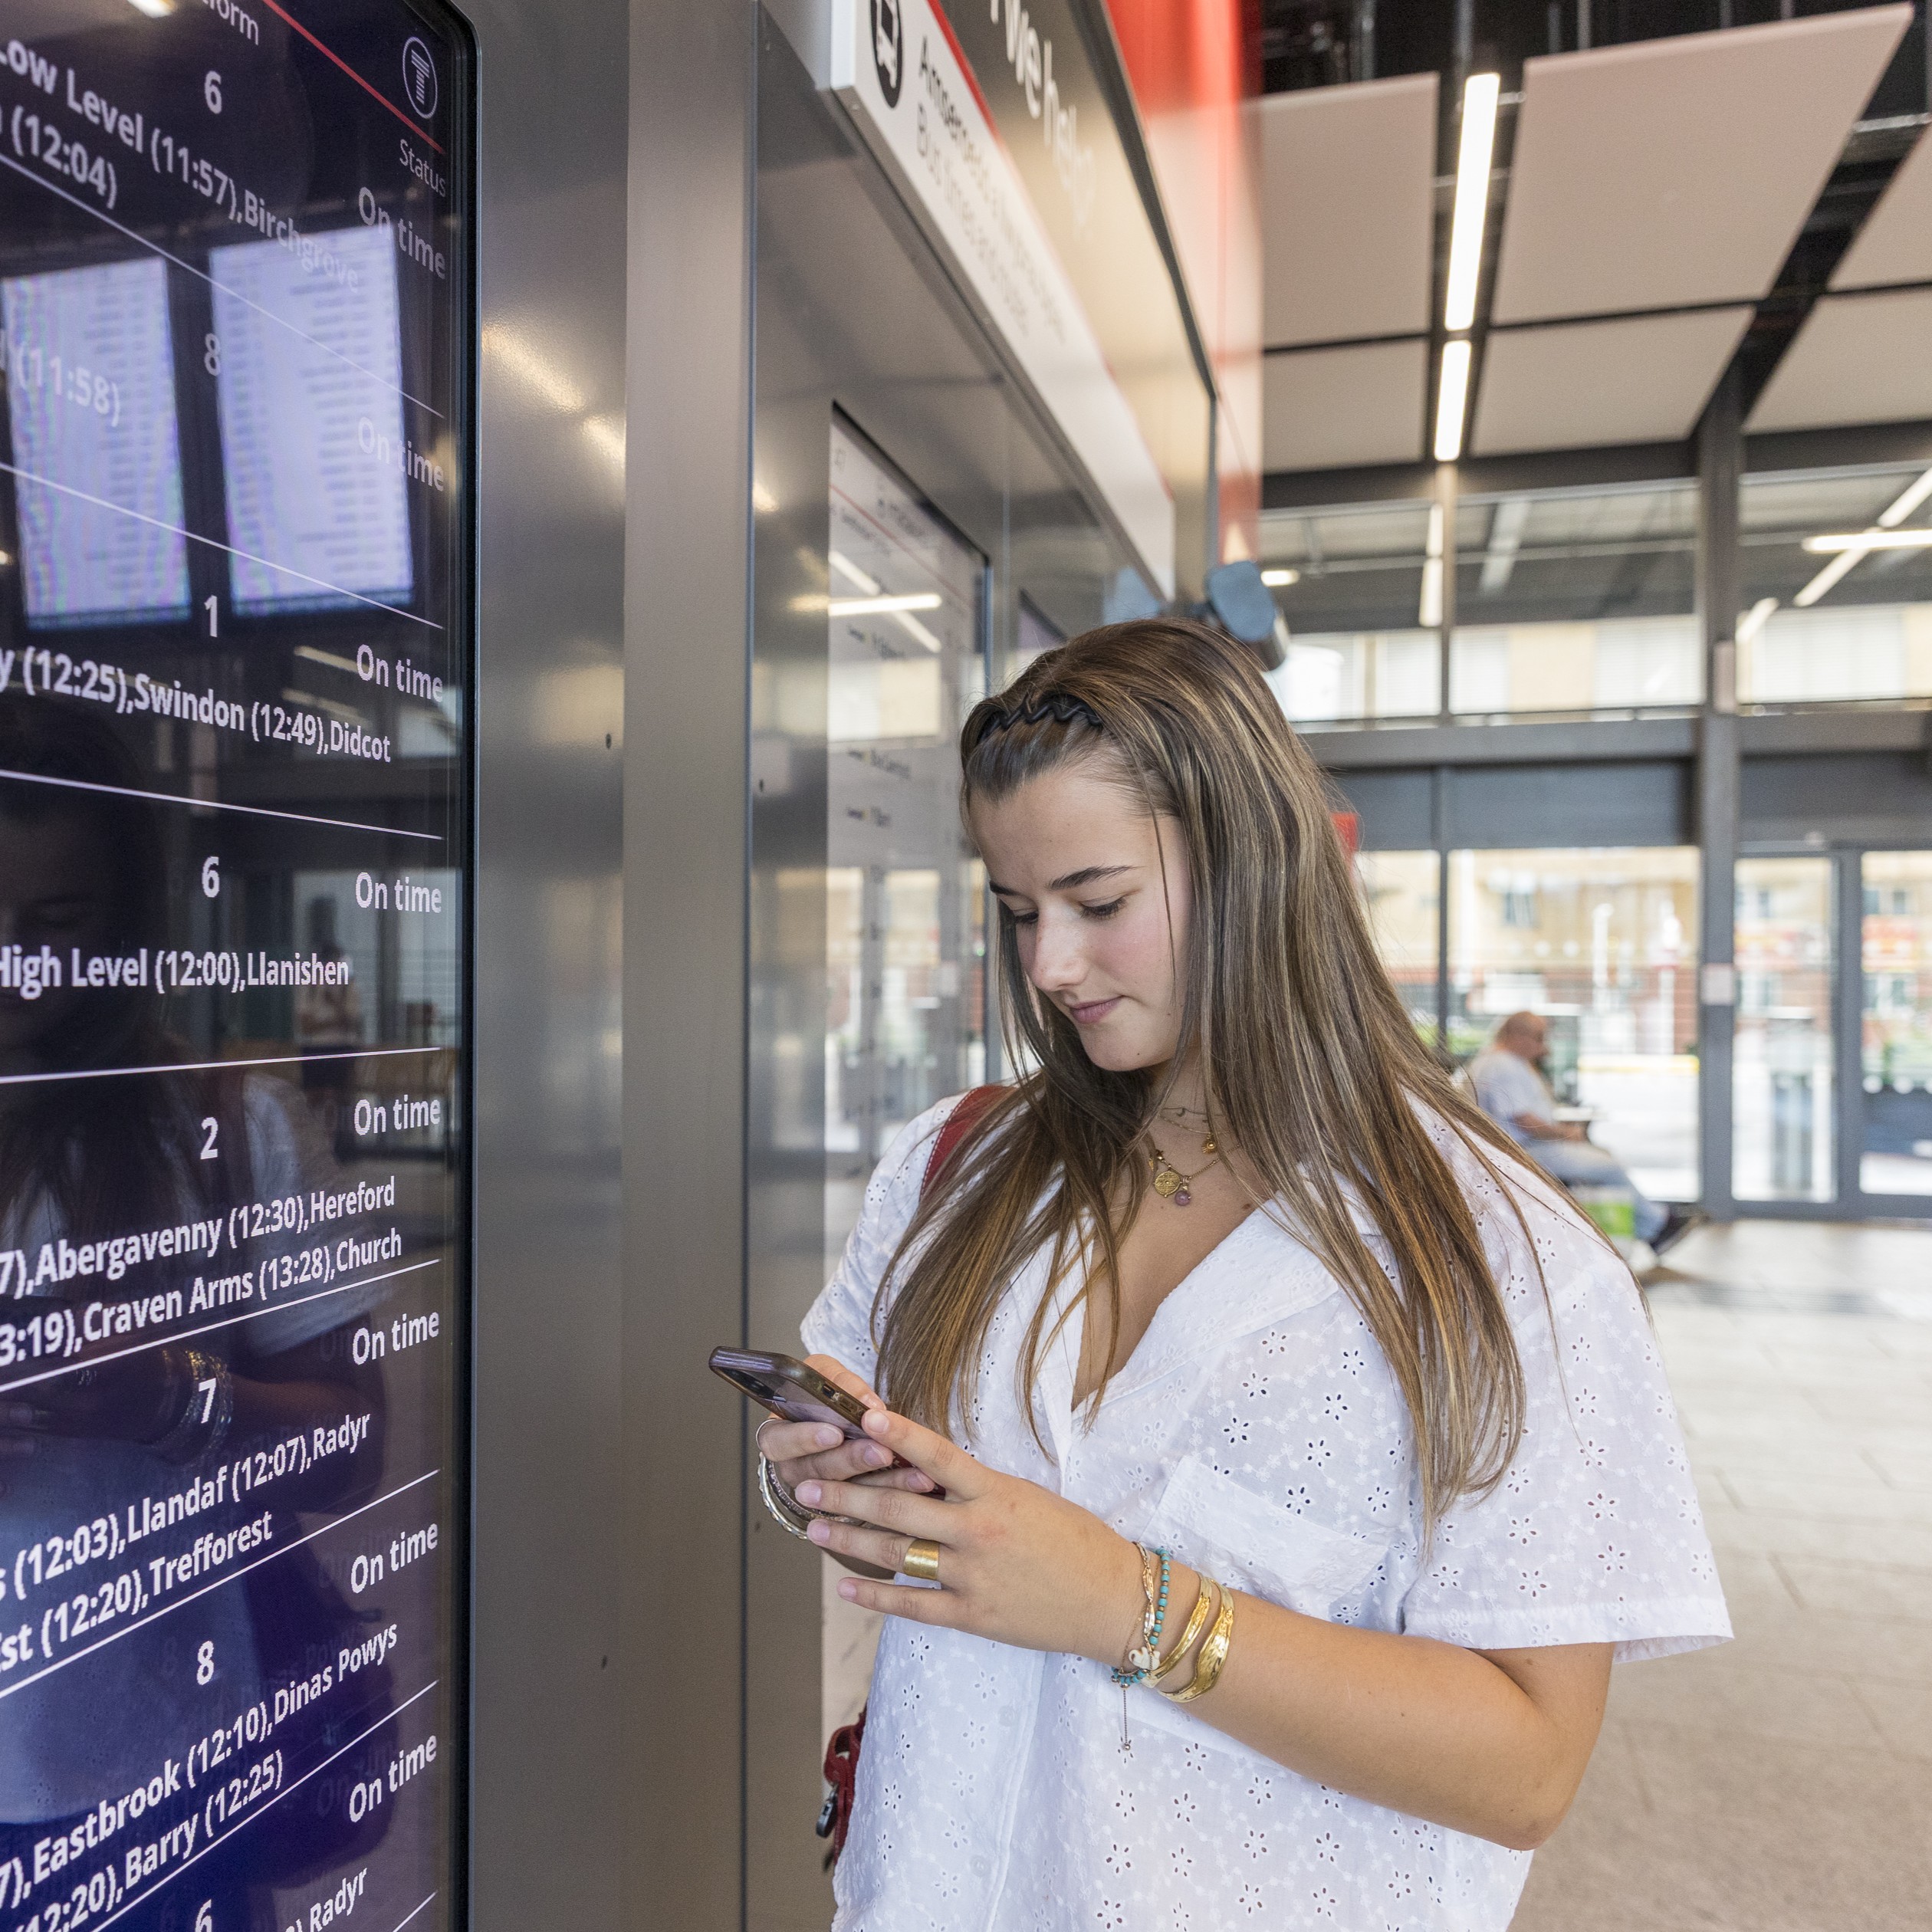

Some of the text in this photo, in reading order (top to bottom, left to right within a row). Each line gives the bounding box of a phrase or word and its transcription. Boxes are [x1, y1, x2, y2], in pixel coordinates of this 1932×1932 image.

[201, 0, 258, 45] orm
[67, 67, 143, 153] Level
[204, 71, 222, 114] 6
[11, 105, 117, 209] (12:04)
[399, 139, 446, 197] Status
[358, 187, 445, 280] On time
[204, 333, 222, 376] 8
[17, 341, 120, 427] (11:58)
[358, 417, 445, 491] On time
[204, 595, 219, 637] 1
[356, 645, 444, 702] On time
[202, 856, 219, 897] 6
[356, 872, 442, 913] On time
[71, 948, 147, 987] Level
[200, 1117, 219, 1159] 2
[354, 1094, 440, 1135] On time
[189, 1272, 253, 1313] Arms
[352, 1310, 439, 1366] On time
[199, 1378, 216, 1424] 7
[350, 1523, 438, 1594] On time
[0, 1624, 33, 1674] st
[196, 1641, 214, 1685] 8
[339, 1624, 397, 1682] Powys
[349, 1735, 437, 1822] On time
[15, 1750, 282, 1932] 2:20),Barry (12:25)
[196, 1899, 212, 1932] 6
